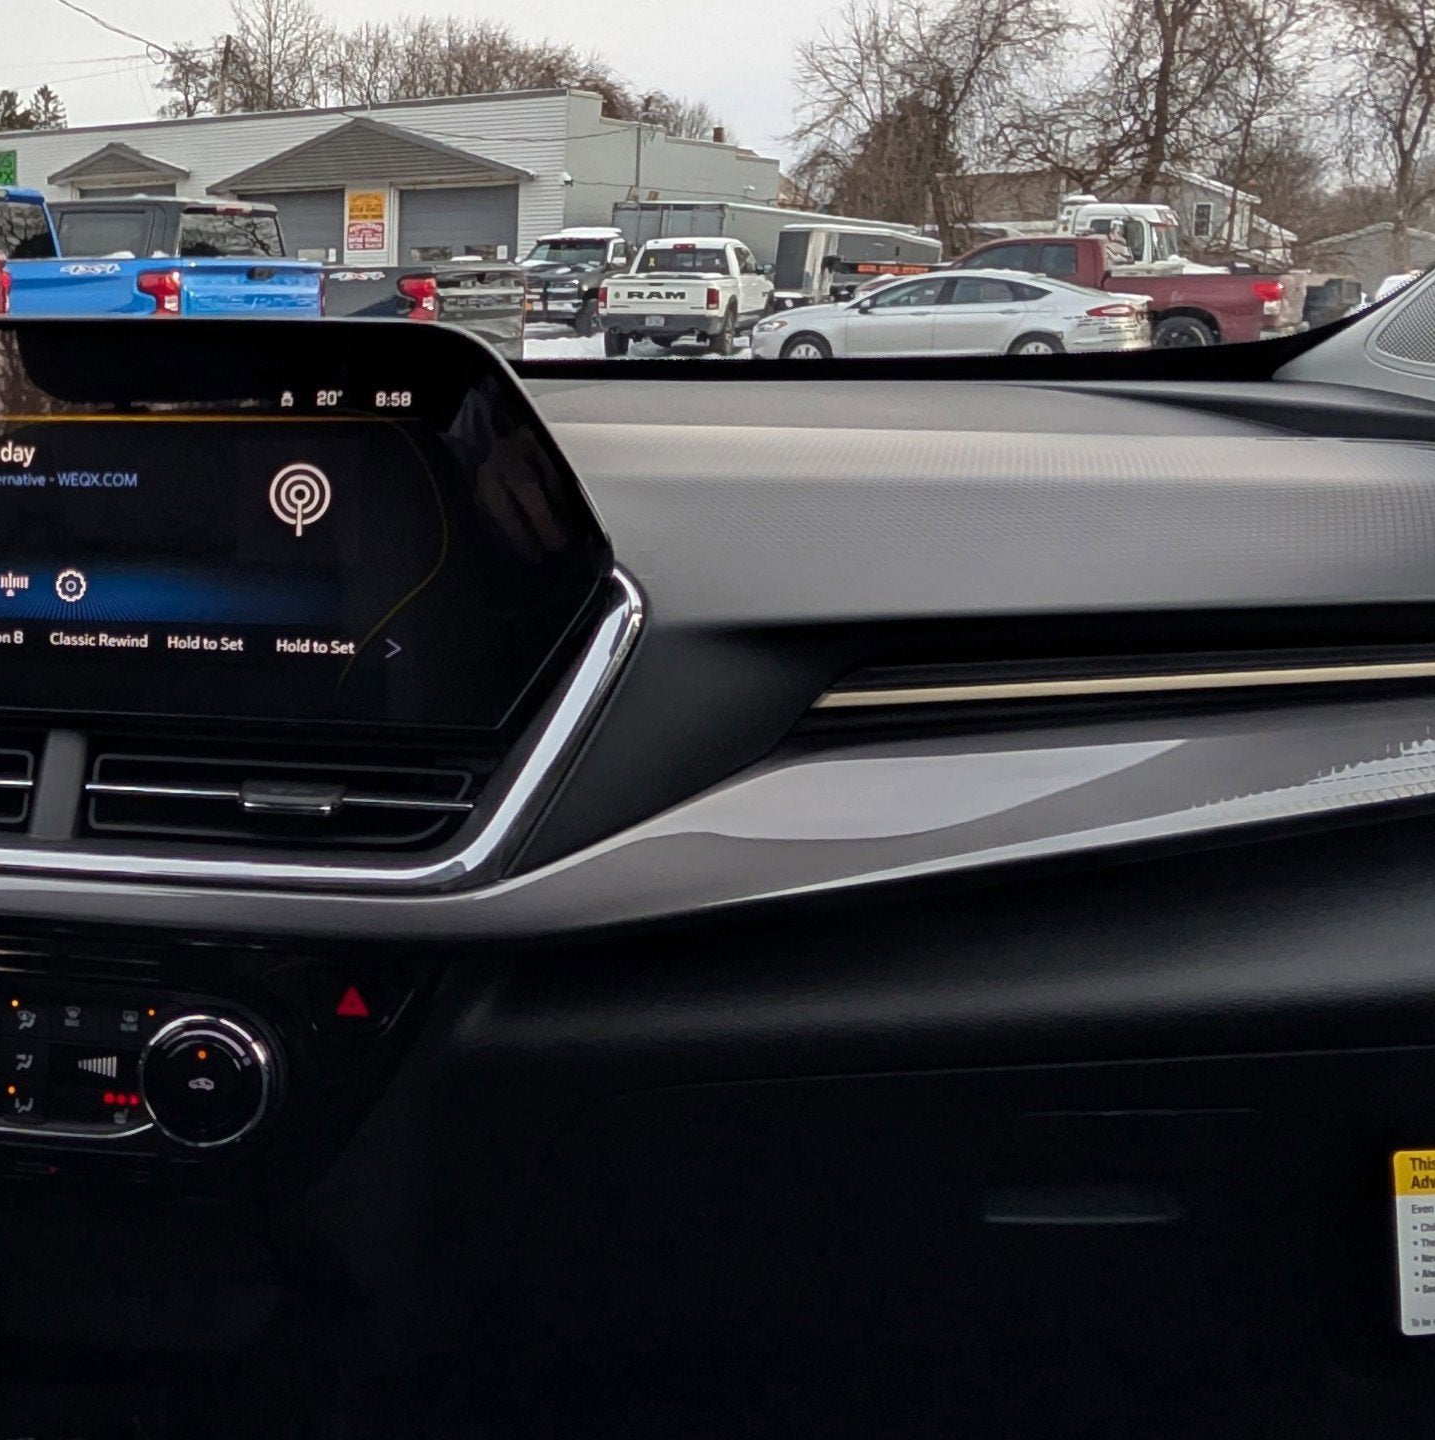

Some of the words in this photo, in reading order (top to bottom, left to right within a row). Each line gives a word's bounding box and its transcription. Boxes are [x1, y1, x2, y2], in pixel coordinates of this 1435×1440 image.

[627, 291, 685, 300] RAM
[375, 390, 412, 407] 8:58
[57, 472, 138, 488] WEQX.COM
[13, 630, 24, 644] 8
[49, 632, 96, 647] Classic
[99, 633, 149, 649] Rewind
[167, 635, 200, 650] Hold
[203, 637, 218, 651] to
[220, 637, 244, 652] Set
[276, 639, 310, 653] Hold
[313, 640, 328, 654] to
[331, 640, 355, 655] Set
[1411, 1204, 1434, 1214] Even
